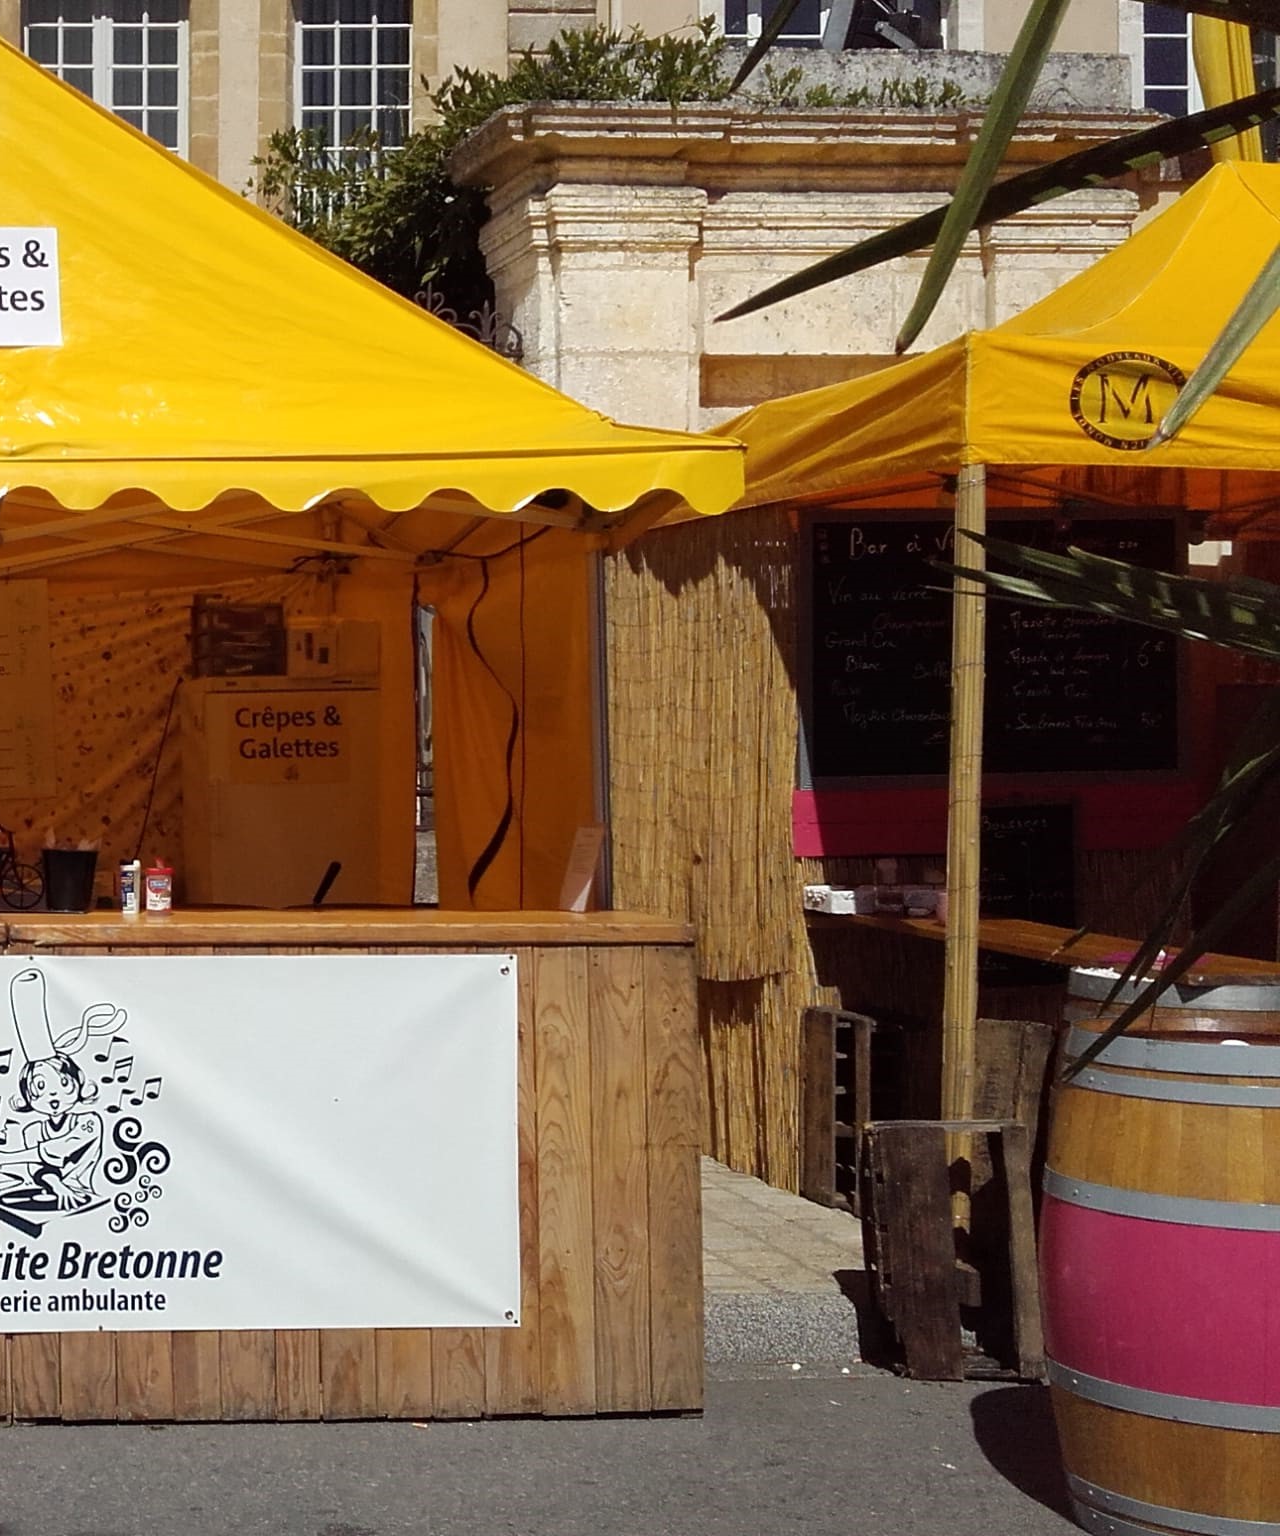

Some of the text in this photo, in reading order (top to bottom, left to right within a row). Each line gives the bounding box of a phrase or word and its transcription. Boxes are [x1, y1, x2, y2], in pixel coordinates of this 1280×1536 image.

[22, 239, 50, 269] &
[1096, 373, 1154, 424] M
[850, 527, 888, 560] Bar
[906, 534, 922, 553] à
[235, 705, 342, 732] Crêpes &
[239, 738, 339, 760] Galettes
[56, 1242, 224, 1282] Bretonne
[46, 1287, 167, 1313] ambulante
